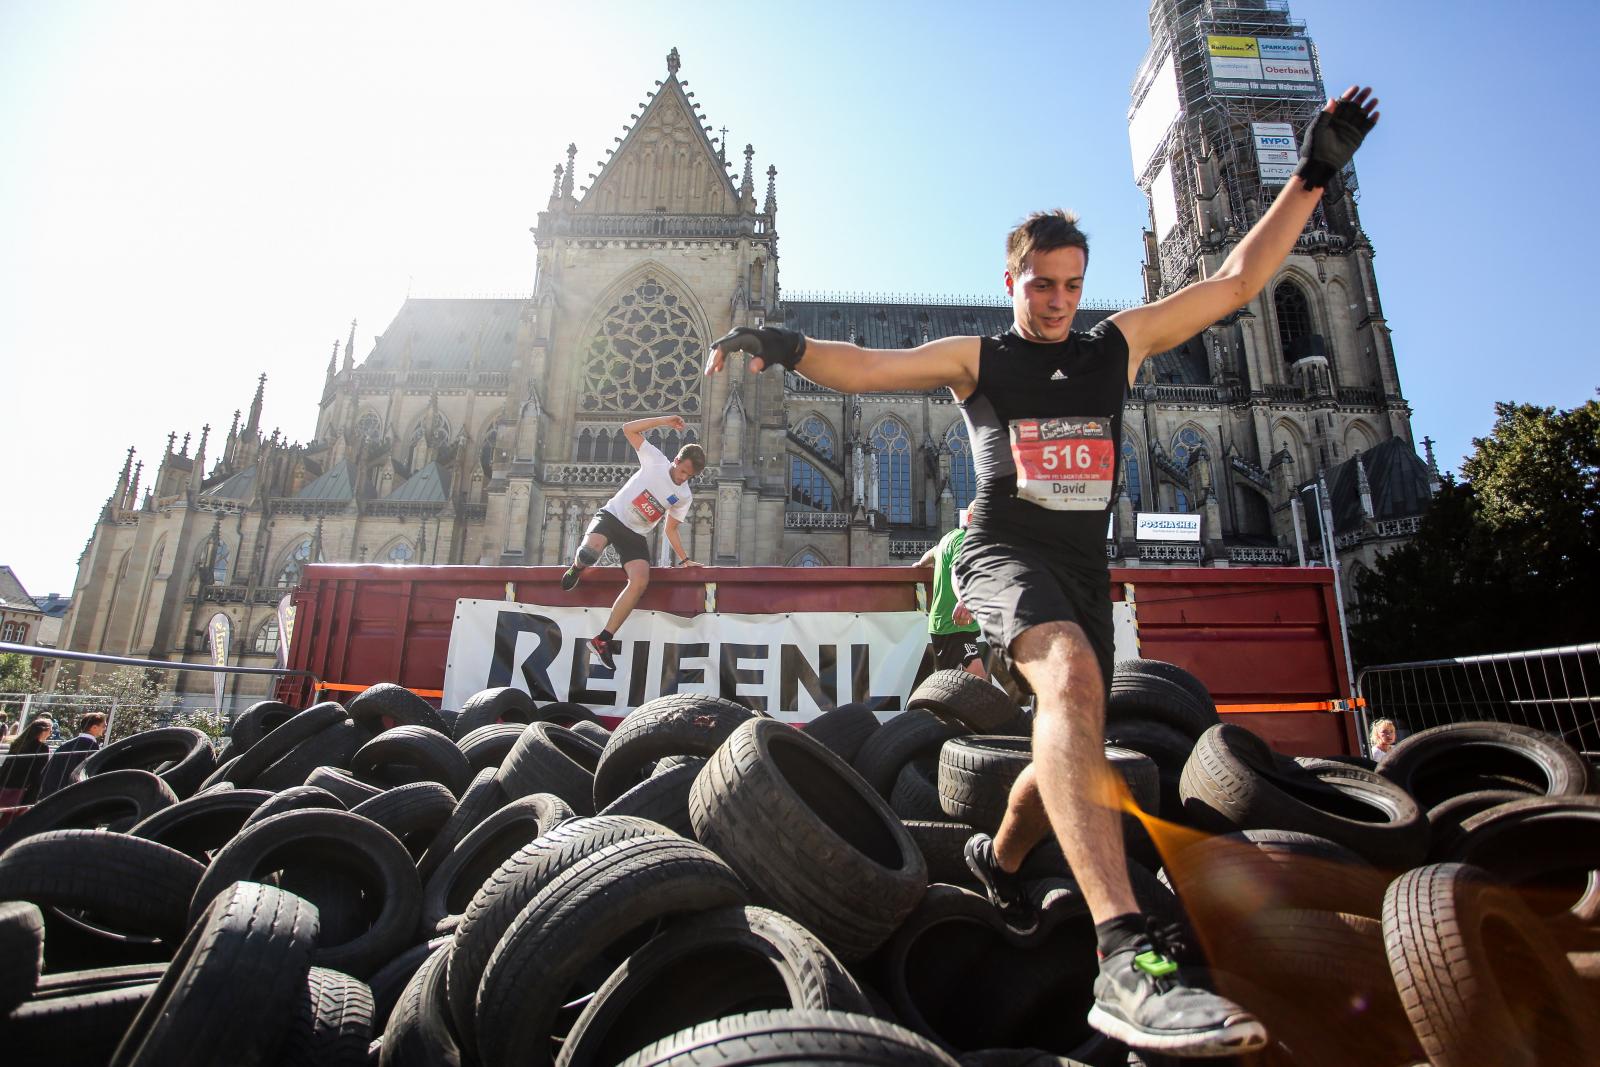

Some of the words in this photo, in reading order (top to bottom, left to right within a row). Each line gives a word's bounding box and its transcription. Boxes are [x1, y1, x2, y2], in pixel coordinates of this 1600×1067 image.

[1265, 66, 1310, 75] Oberbank
[1260, 137, 1290, 145] HYPO
[1042, 444, 1092, 470] 516
[1052, 482, 1086, 494] David
[641, 502, 655, 516] 450
[1140, 520, 1197, 529] POSCHACHER
